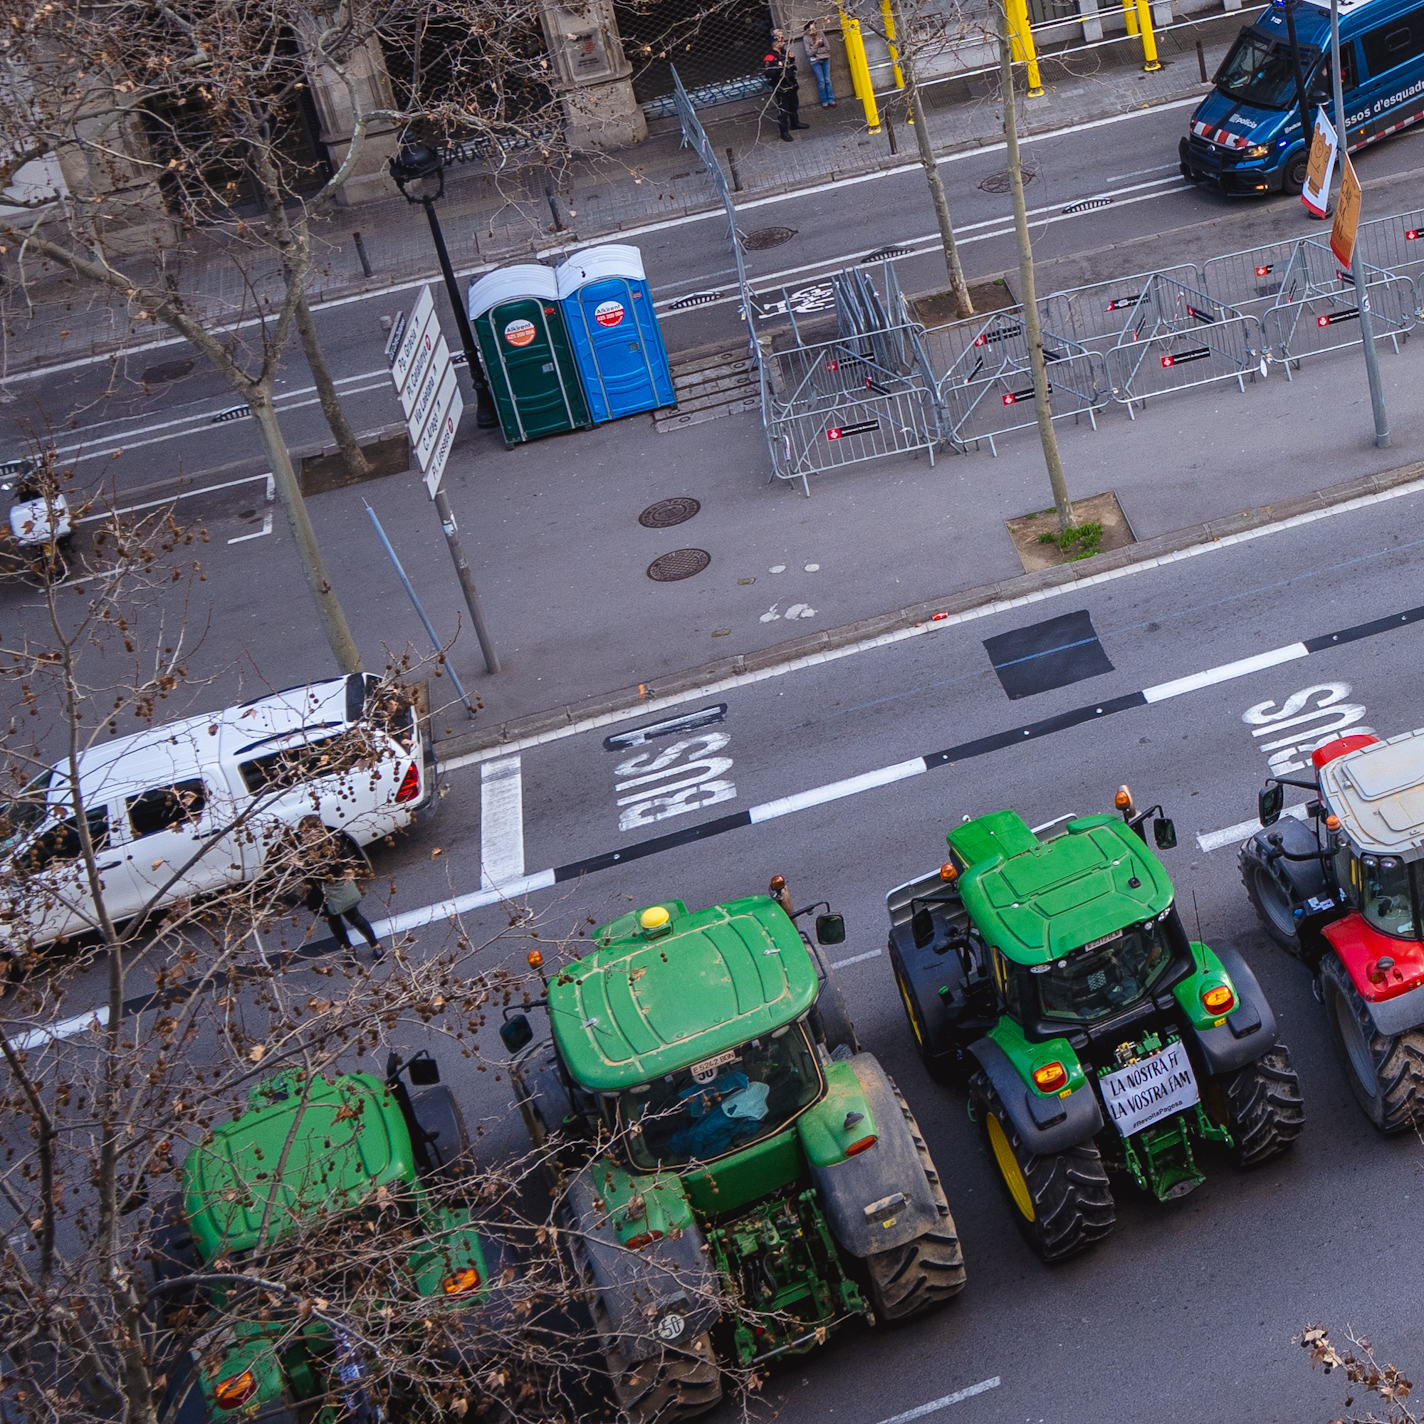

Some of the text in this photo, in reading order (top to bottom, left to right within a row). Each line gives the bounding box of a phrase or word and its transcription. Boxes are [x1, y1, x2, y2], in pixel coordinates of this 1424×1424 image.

[1237, 115, 1257, 130] policia
[596, 304, 621, 315] Alkirent
[506, 323, 531, 333] Alkirent
[614, 732, 738, 832] BUS
[1110, 1079, 1126, 1096] LA
[1126, 1058, 1169, 1088] NOSTRA
[1111, 1070, 1192, 1120] LA VOSTRA FAM
[1133, 1100, 1183, 1129] #RevoltaPagesa
[661, 1316, 681, 1338] 50
